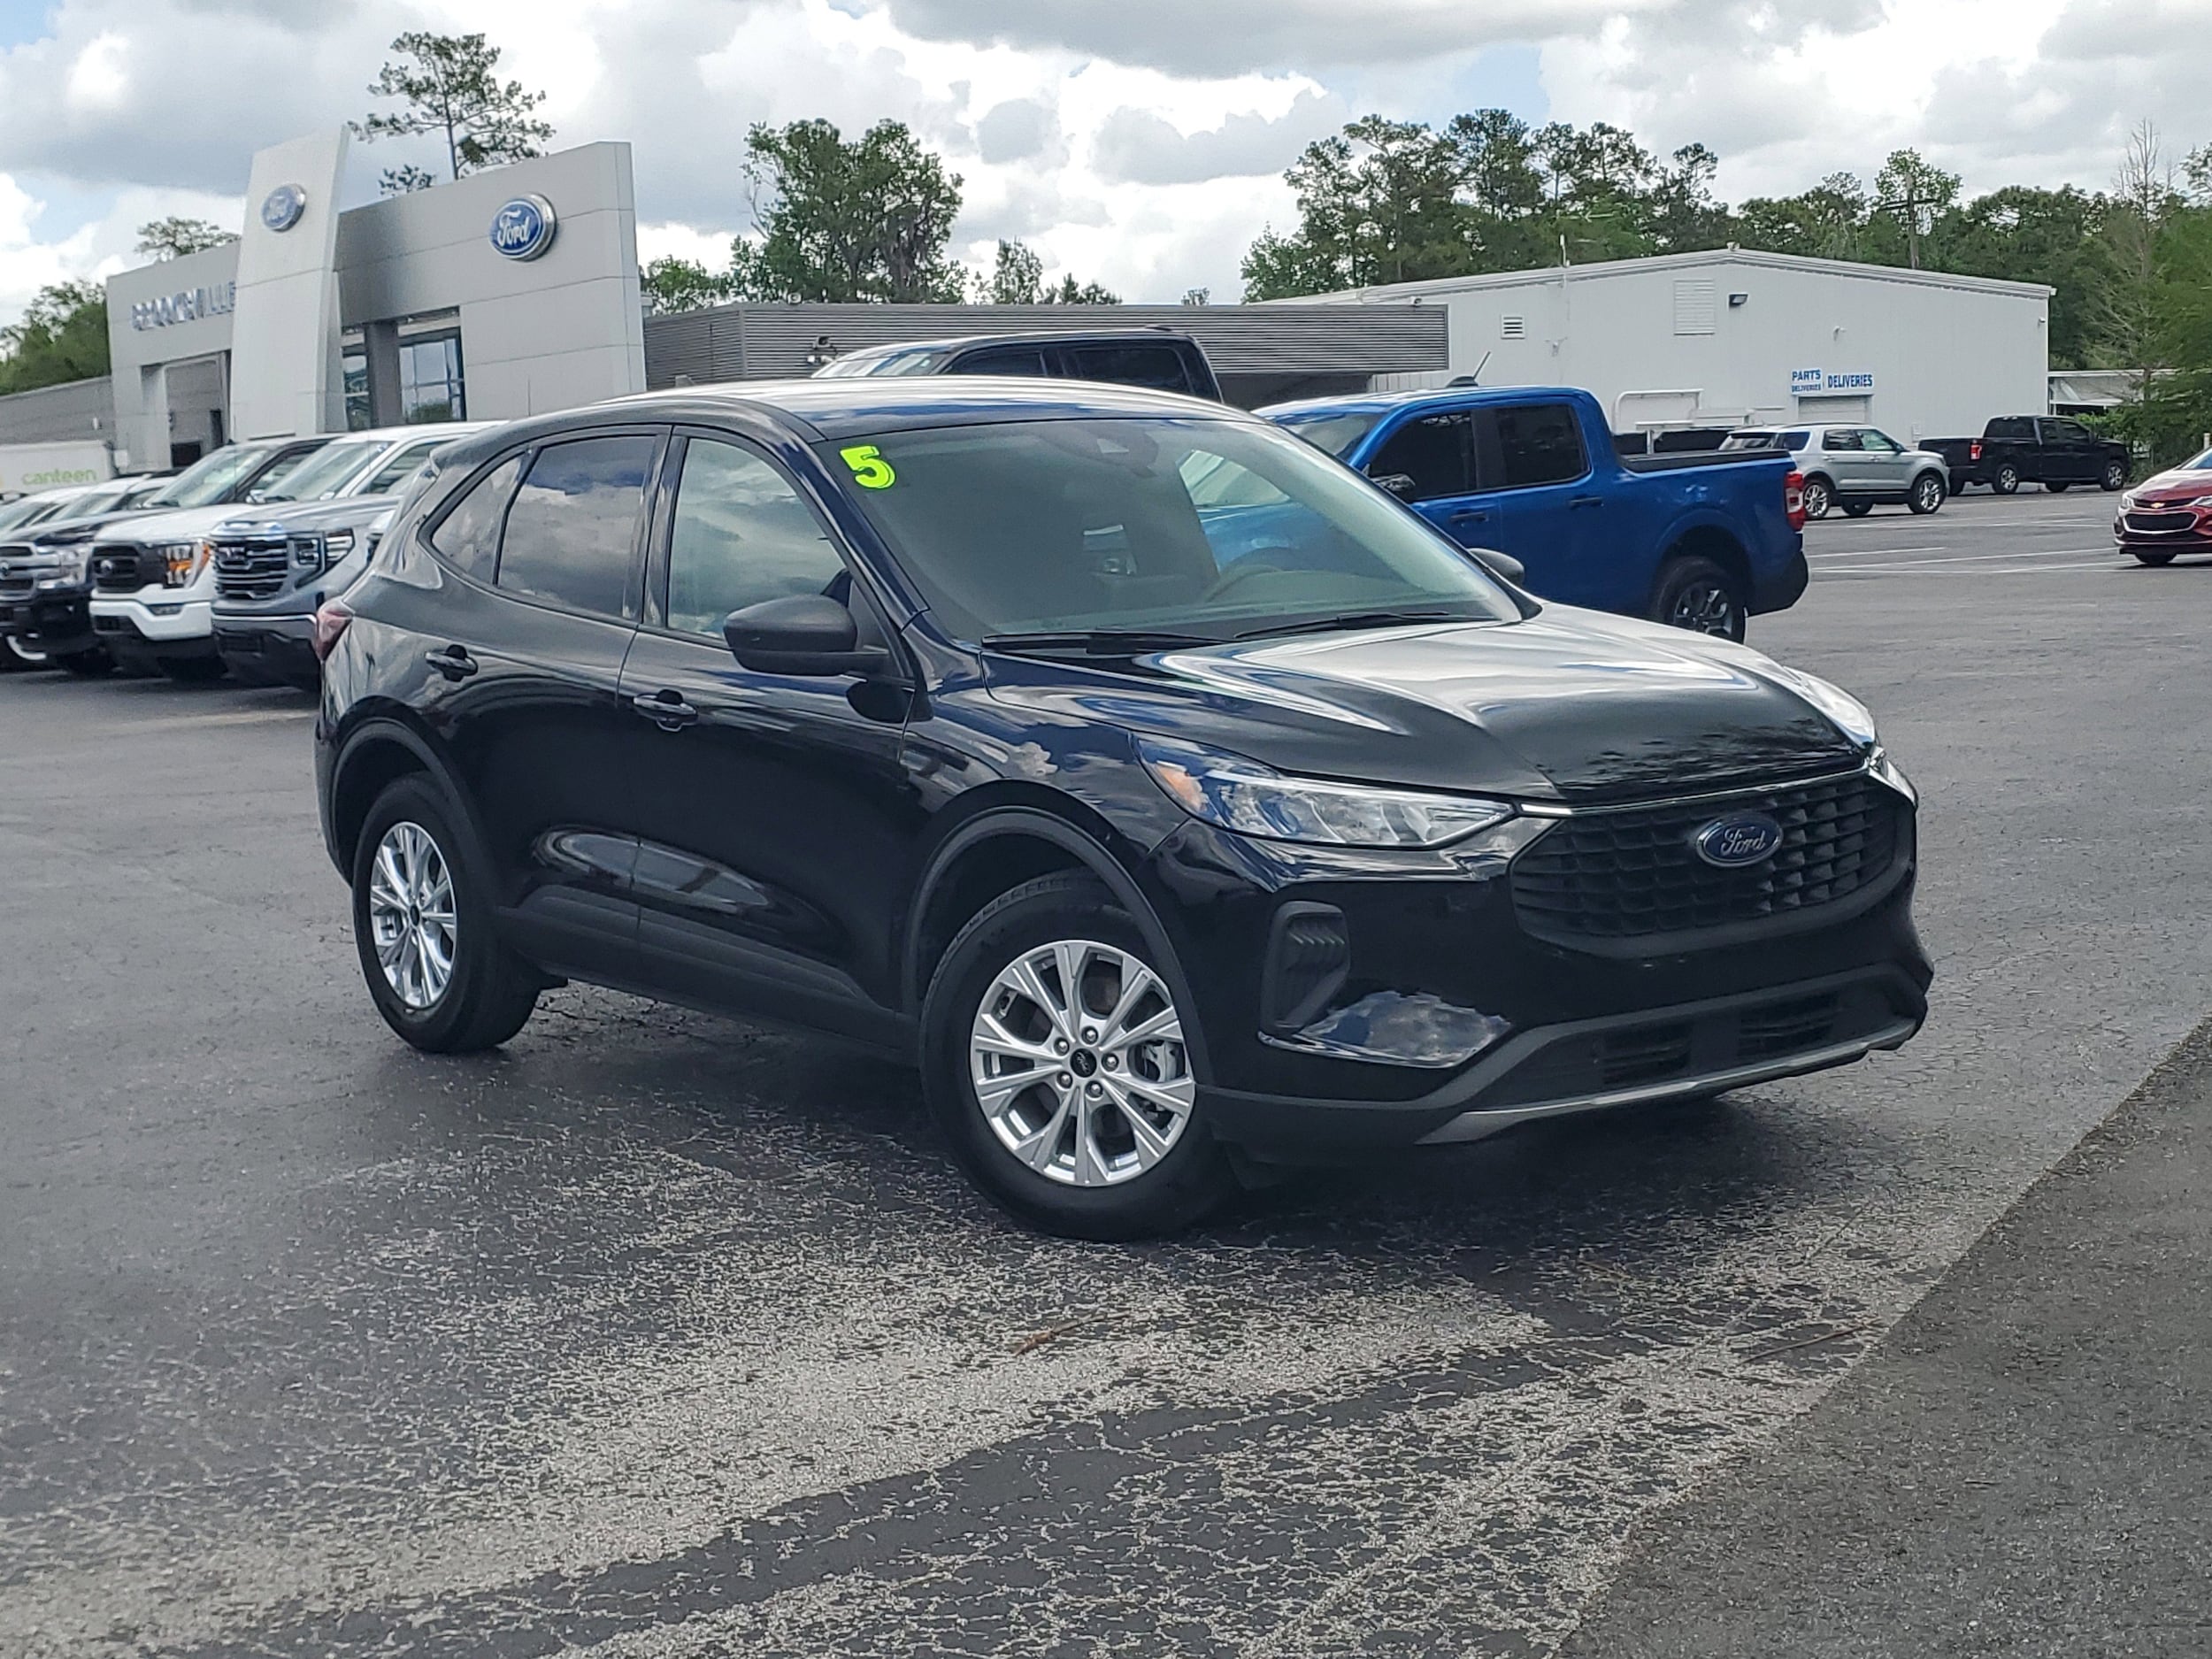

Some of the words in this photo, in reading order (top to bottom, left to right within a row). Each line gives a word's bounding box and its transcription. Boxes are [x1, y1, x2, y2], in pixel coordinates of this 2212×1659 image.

[497, 210, 530, 247] Ford
[1792, 369, 1821, 381] PARTS
[1827, 374, 1873, 388] DELIVERIES
[21, 469, 97, 486] canteen
[840, 445, 896, 488] 5
[1720, 826, 1766, 856] Ford
